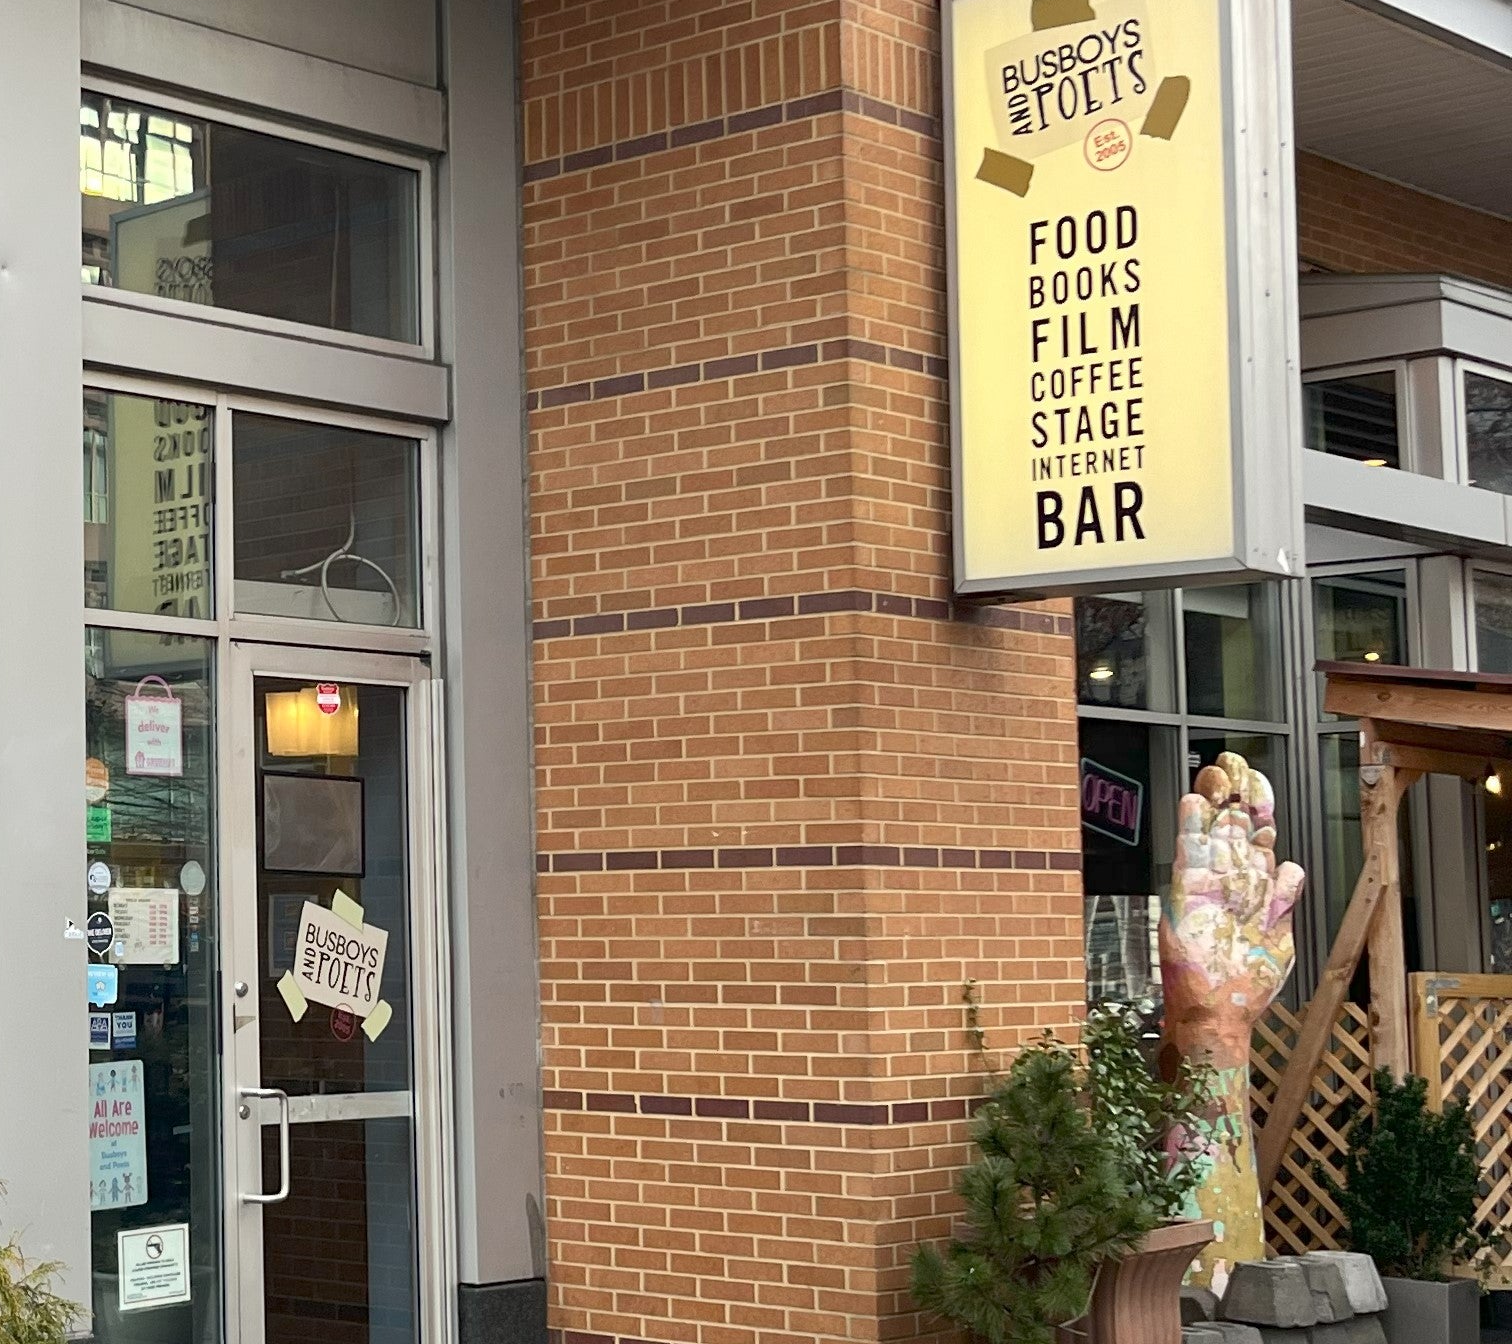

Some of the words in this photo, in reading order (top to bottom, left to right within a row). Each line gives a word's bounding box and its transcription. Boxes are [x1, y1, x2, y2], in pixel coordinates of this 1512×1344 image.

[1002, 18, 1141, 94] BUSBOYS
[1007, 93, 1035, 136] AND
[1030, 49, 1147, 132] POETS
[1094, 140, 1127, 163] 2005
[1029, 204, 1138, 265] FOOD
[1029, 258, 1140, 310] BOOKS
[1031, 303, 1140, 363] FILM
[1031, 356, 1143, 402] COFFEE
[1031, 397, 1144, 449] STAGE
[1032, 444, 1146, 482] INTERNET
[1035, 480, 1146, 550] BAR
[137, 719, 170, 733] deliver
[1083, 773, 1138, 830] OPEN
[305, 922, 379, 969] BUSBOYS
[301, 947, 317, 982] AND
[315, 950, 376, 1003] POETS
[116, 1021, 133, 1029] YOU
[89, 1119, 139, 1139] Welcome
[93, 1099, 107, 1118] All
[111, 1099, 132, 1117] Are
